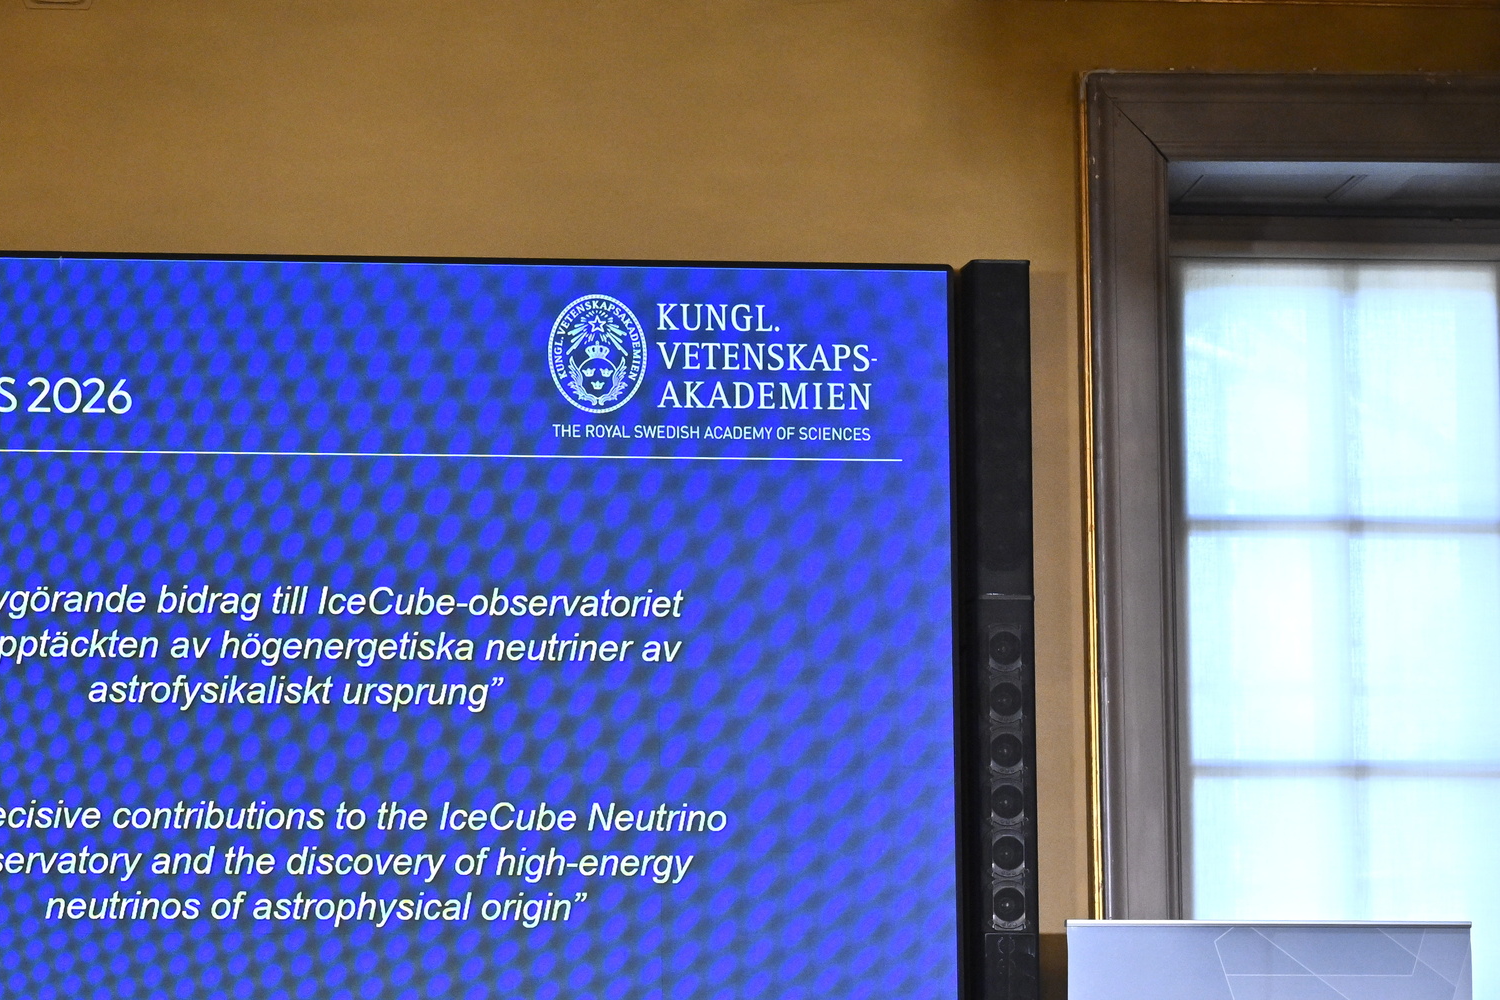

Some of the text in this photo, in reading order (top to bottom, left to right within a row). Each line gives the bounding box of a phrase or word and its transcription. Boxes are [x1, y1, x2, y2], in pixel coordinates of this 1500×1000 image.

[657, 304, 779, 331] KUNGL.
[554, 300, 642, 381] KUNGL. VETENSKAPSAKADEMIEN
[657, 342, 877, 371] VETENSKAPS-
[28, 377, 132, 414] 2026
[657, 381, 871, 410] AKADEMIEN
[553, 424, 870, 440] THE ROYAL SWEDISH ACADEMY OF SCIENCES
[157, 585, 261, 621] bidrag
[273, 586, 308, 614] till
[319, 586, 683, 617] IceCube-observatoriet
[171, 637, 211, 658] av
[220, 630, 473, 666] högenergetiska
[485, 633, 634, 661] neutriner
[642, 641, 682, 662] av
[89, 675, 504, 712] astrofysikaliskt ursprung”
[113, 801, 325, 829] contributions
[336, 802, 365, 829] to
[378, 802, 427, 830] the
[440, 802, 576, 830] IceCube
[588, 803, 726, 831] Neutrino
[152, 846, 215, 874] and
[225, 846, 275, 874] the
[287, 846, 446, 882] discovery
[455, 847, 490, 875] of
[496, 847, 693, 883] high-energy
[45, 891, 587, 928] neutrinos of astrophysical origin”
